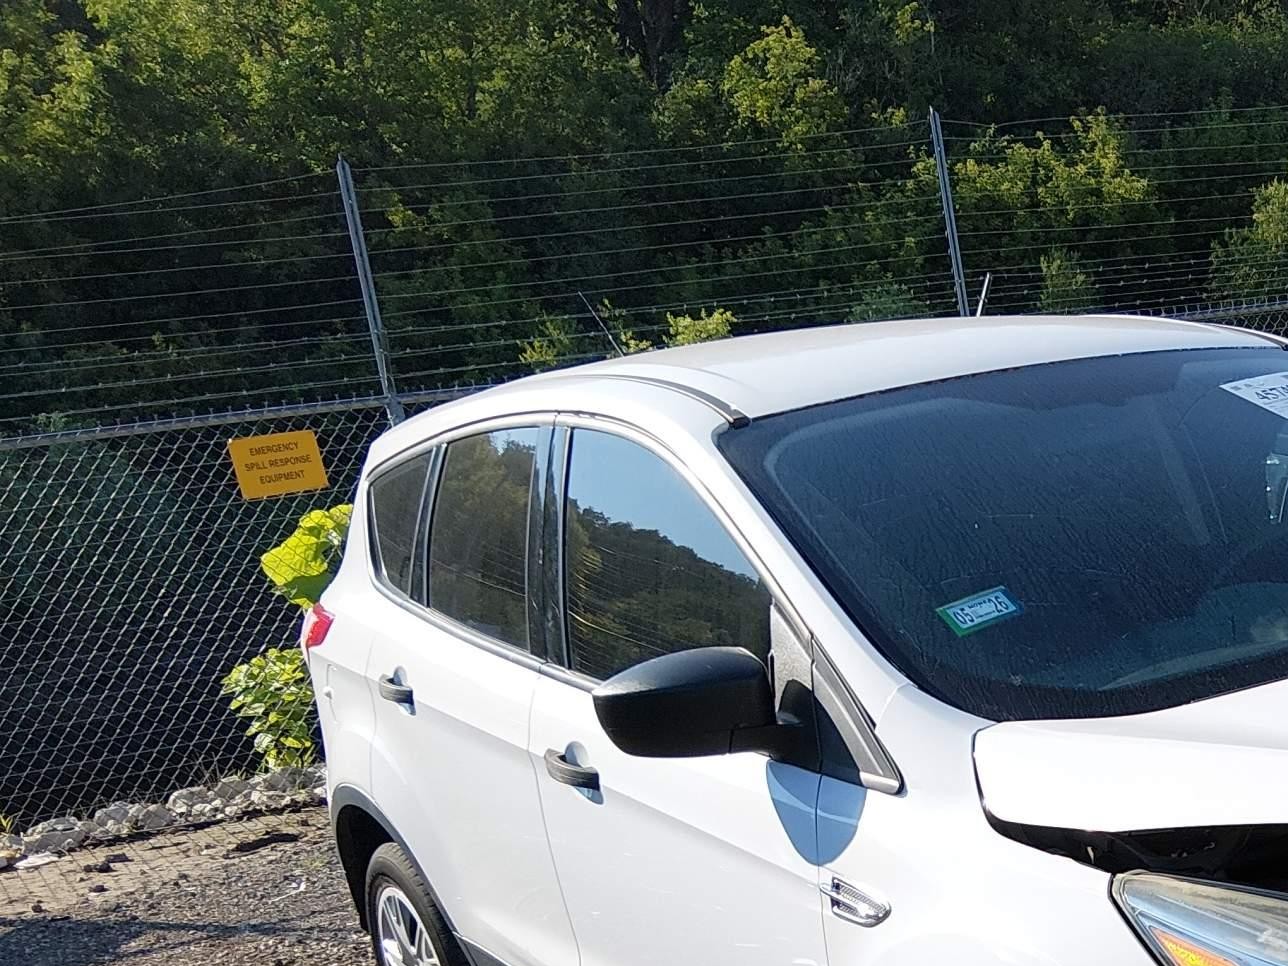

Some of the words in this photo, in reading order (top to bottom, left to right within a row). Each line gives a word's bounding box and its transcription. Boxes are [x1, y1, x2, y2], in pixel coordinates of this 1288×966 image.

[249, 441, 299, 456] EMERGENCY
[244, 461, 268, 472] SPILL
[268, 454, 313, 469] RESPONSE
[259, 470, 305, 484] EQUIPMENT
